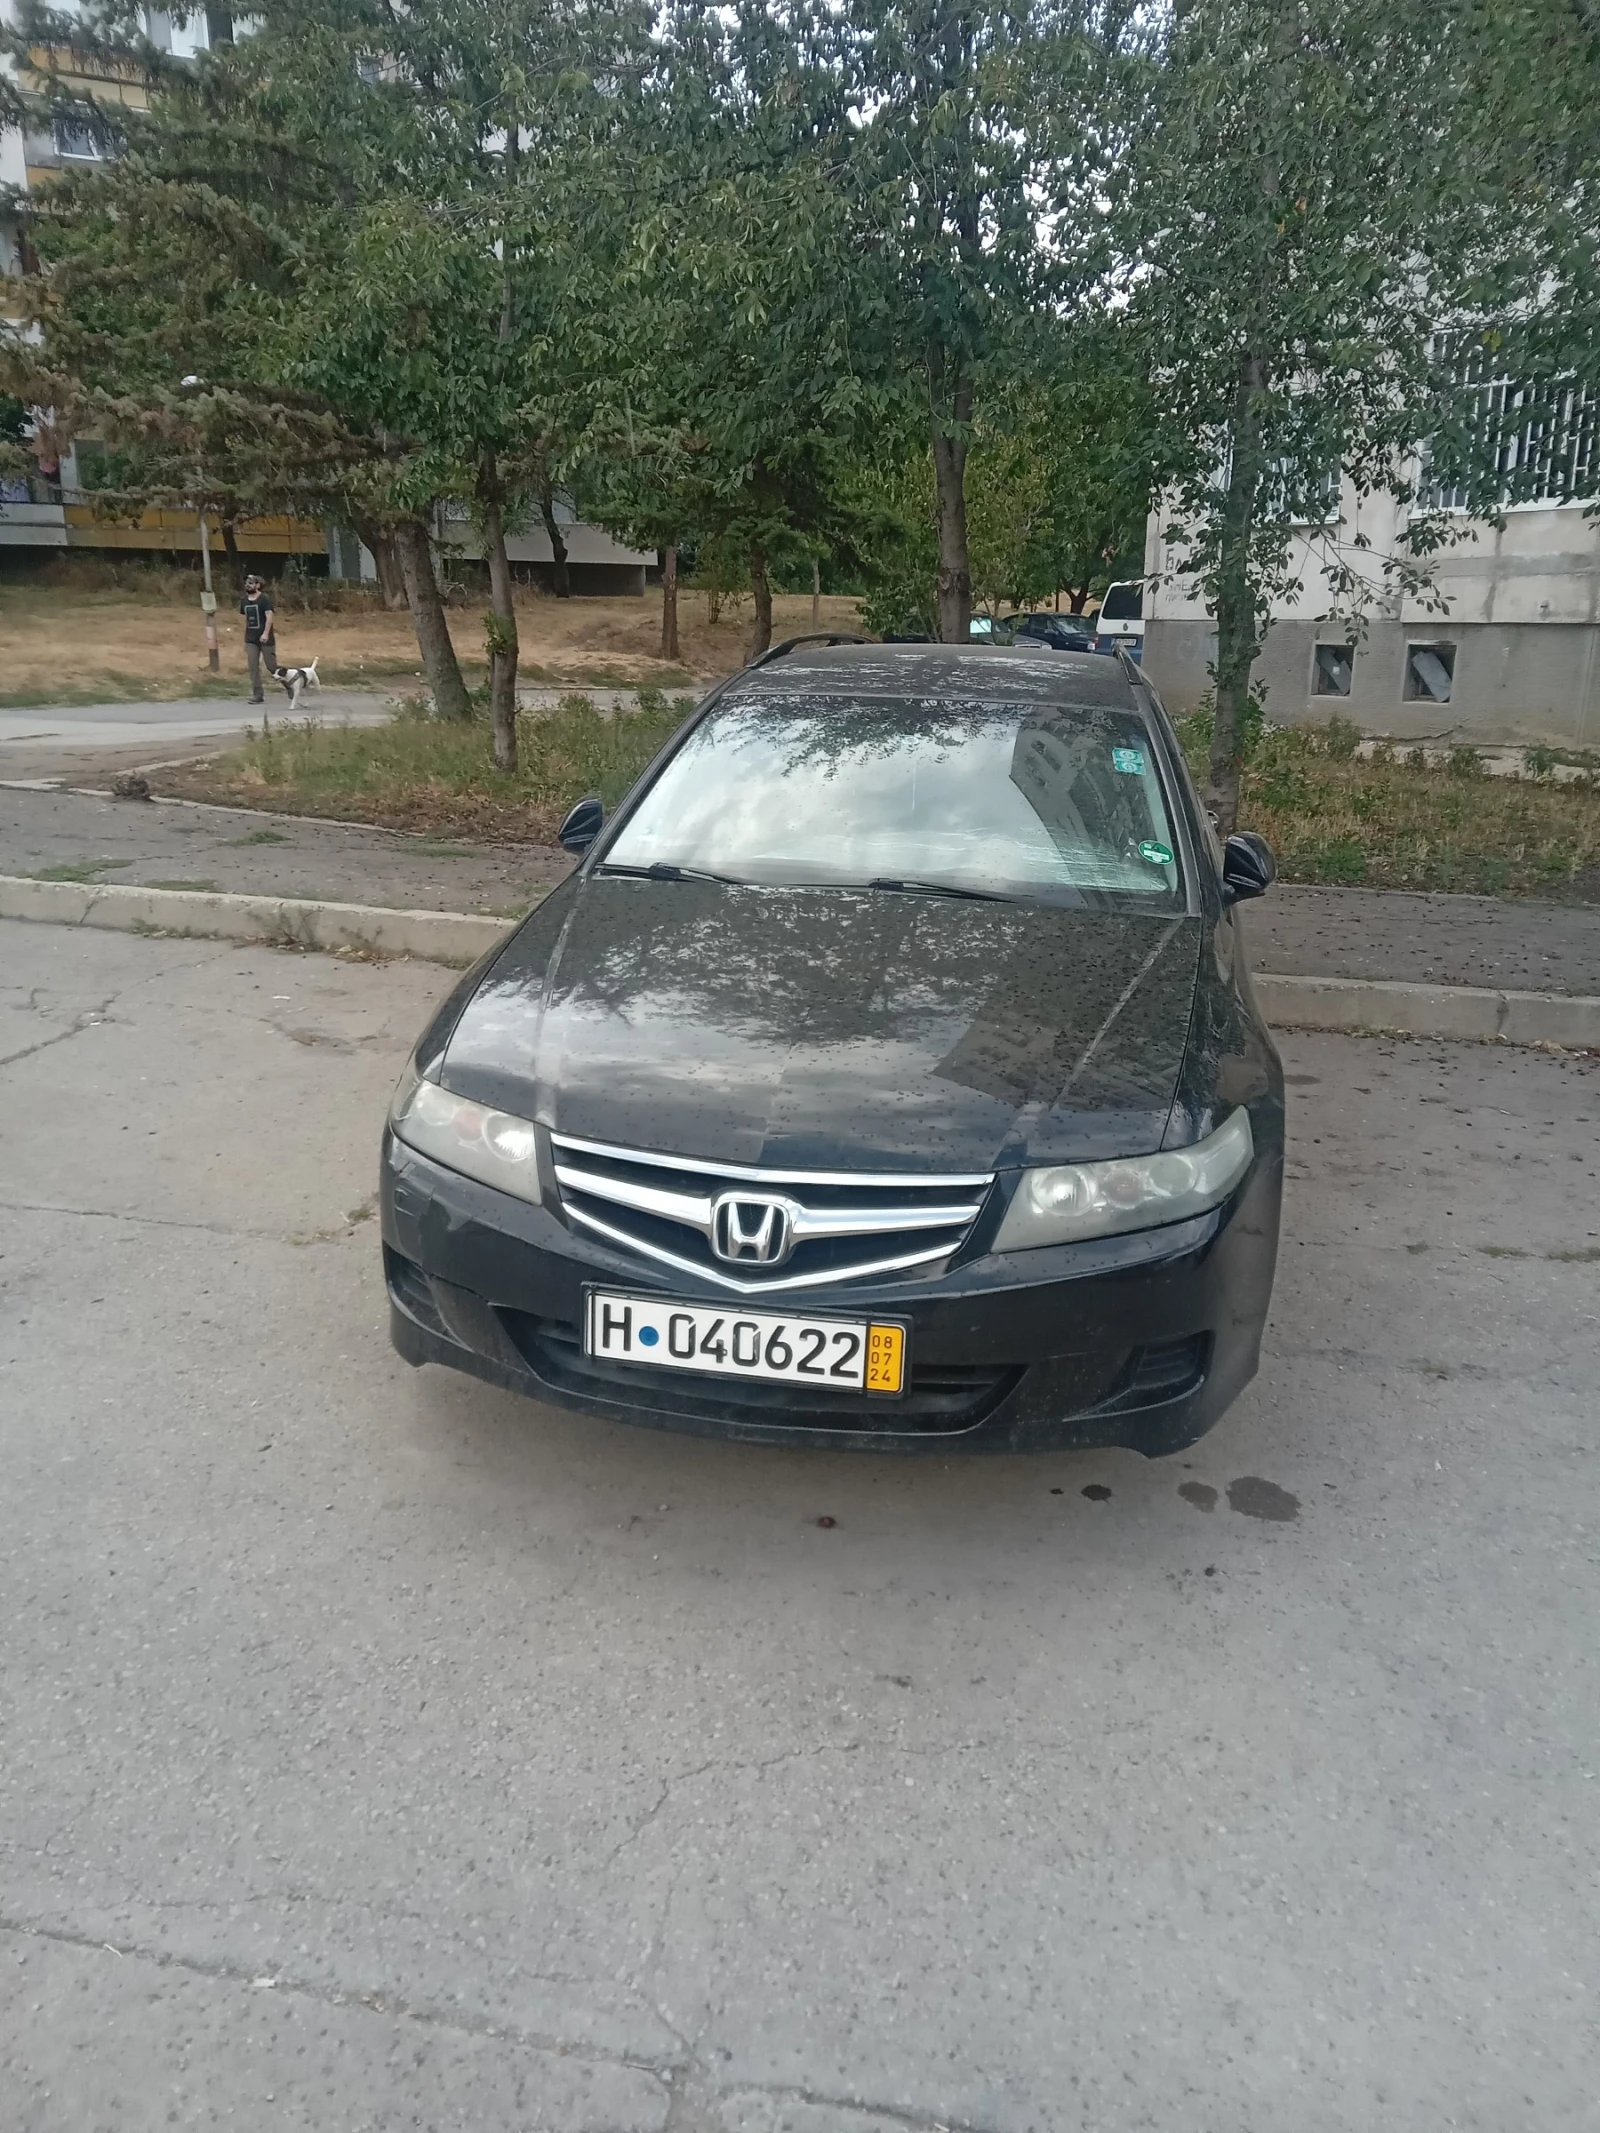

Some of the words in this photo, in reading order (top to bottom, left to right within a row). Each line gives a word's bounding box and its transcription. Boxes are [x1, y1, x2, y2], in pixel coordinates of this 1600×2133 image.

[602, 1303, 632, 1351] H
[668, 1313, 860, 1379] 040622
[872, 1334, 893, 1349] 08
[871, 1351, 892, 1366] 07
[870, 1368, 891, 1383] 24
